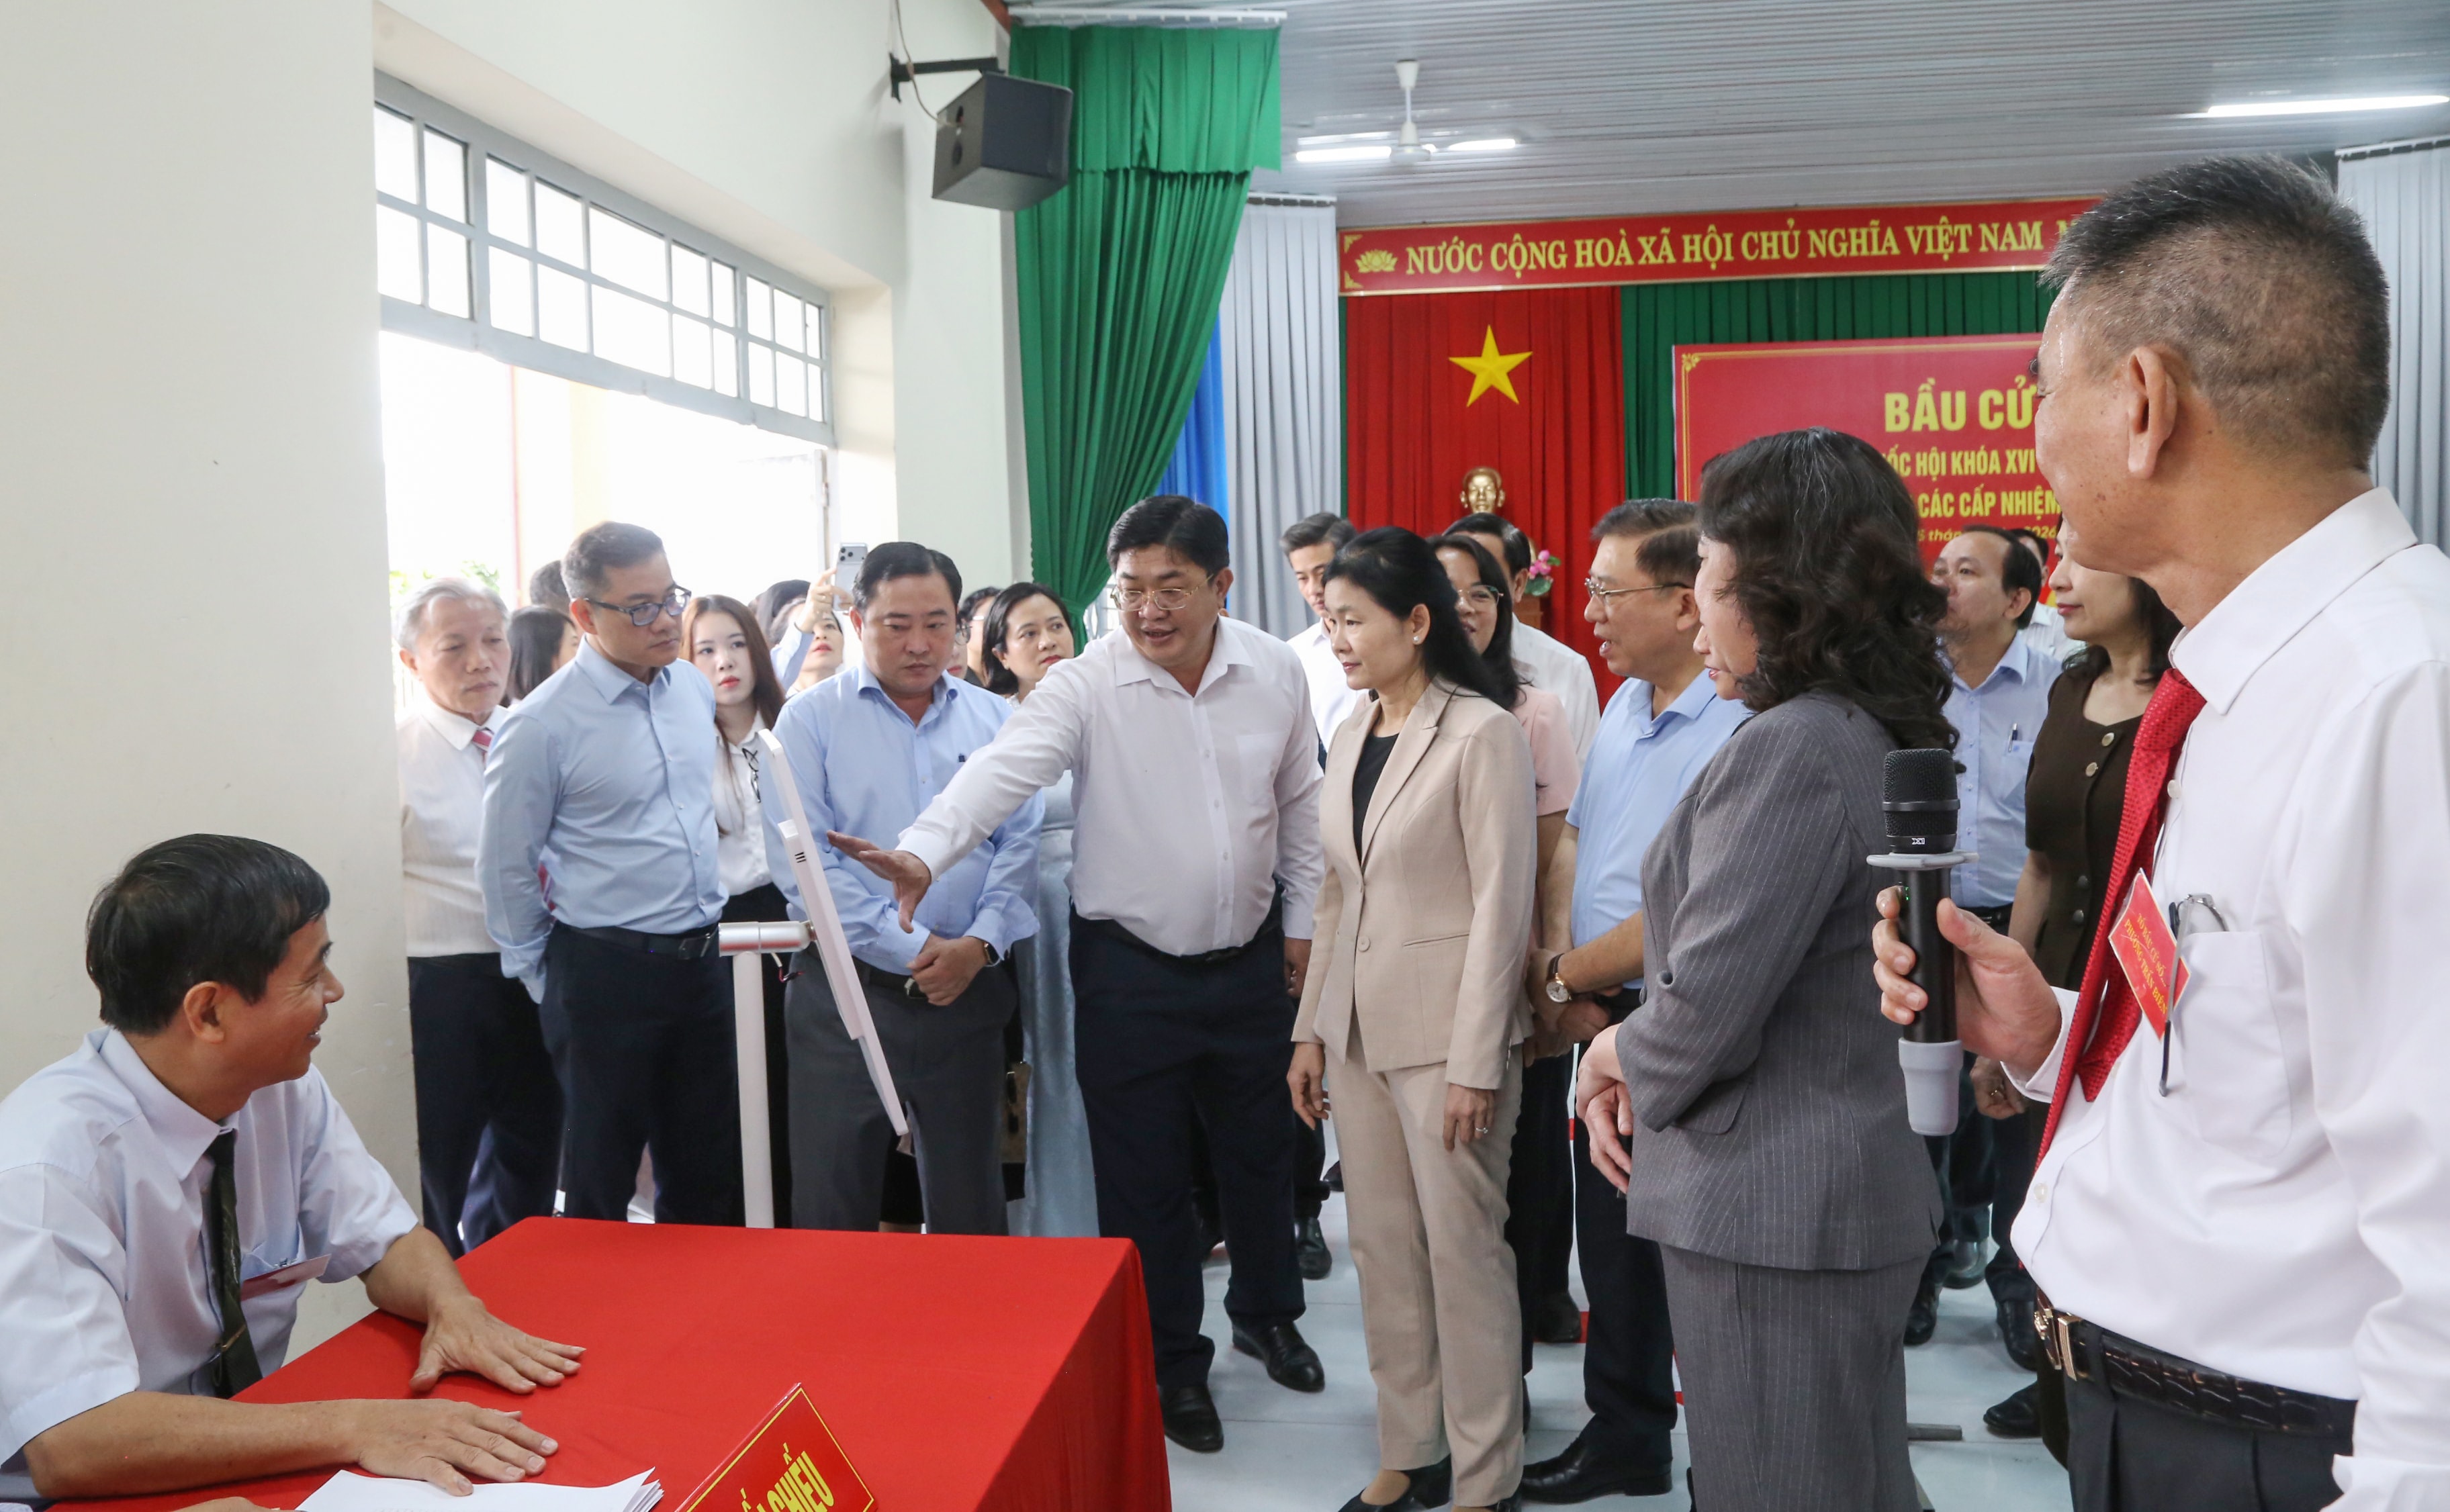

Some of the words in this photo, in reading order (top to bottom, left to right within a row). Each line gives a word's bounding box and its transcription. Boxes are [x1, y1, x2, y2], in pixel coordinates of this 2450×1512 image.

[1406, 236, 1483, 275] NƯỚC
[1490, 233, 1568, 279] CỘNG
[1574, 228, 1634, 268] HOÀ
[1637, 227, 1676, 265] XÃ
[1682, 224, 1735, 271] HỘI
[1741, 218, 1801, 261] CHỦ
[1807, 219, 1901, 258] NGHĨA
[1905, 216, 1972, 261] VIỆT
[1979, 220, 2044, 253] NAM
[1884, 377, 1966, 433] BẦU
[1979, 375, 2038, 430] CỬ
[1915, 446, 1946, 482] HỘI
[1951, 445, 2001, 475] KHÓA
[1917, 487, 1954, 518] CÁC
[1959, 483, 1996, 517] CẤP
[2001, 485, 2061, 520] NHIỆM
[2024, 526, 2056, 538] 026
